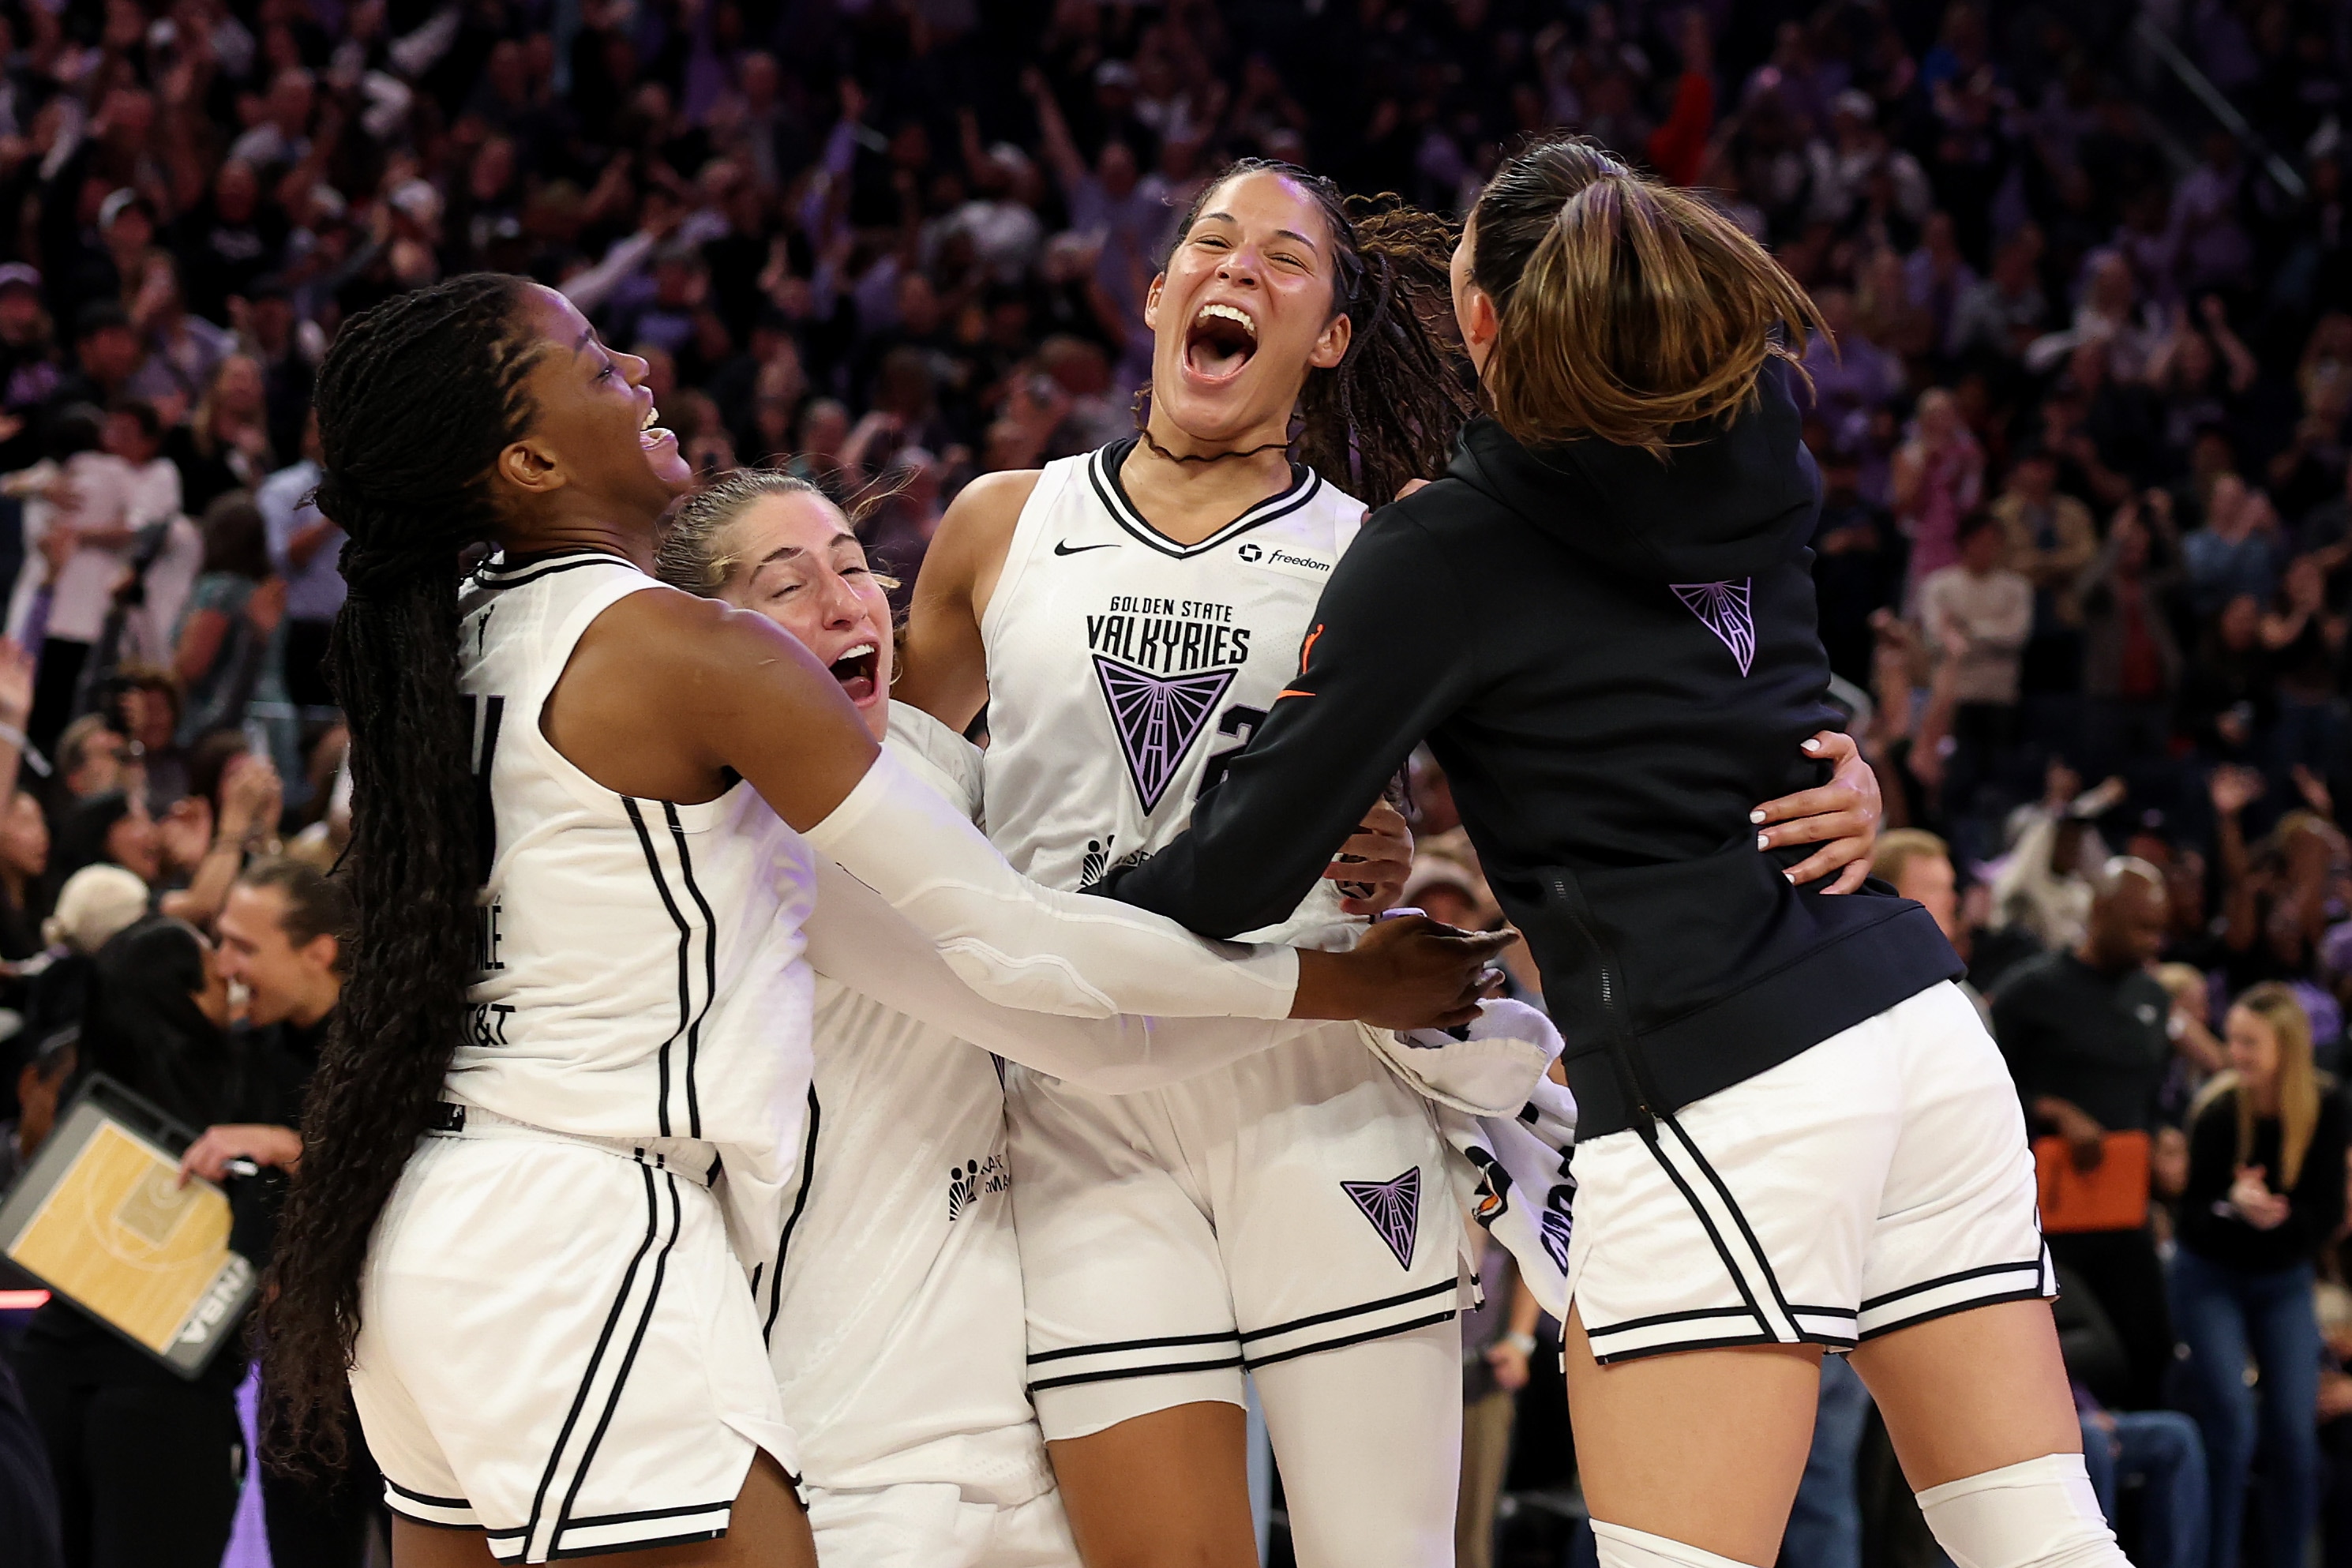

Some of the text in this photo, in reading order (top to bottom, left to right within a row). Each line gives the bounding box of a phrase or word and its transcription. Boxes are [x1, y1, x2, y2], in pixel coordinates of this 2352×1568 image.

[1267, 550, 1330, 572] freedom
[1110, 596, 1233, 622] GOLDEN STATE
[1086, 615, 1251, 673] VALKYRIES
[461, 1003, 516, 1047] T&T
